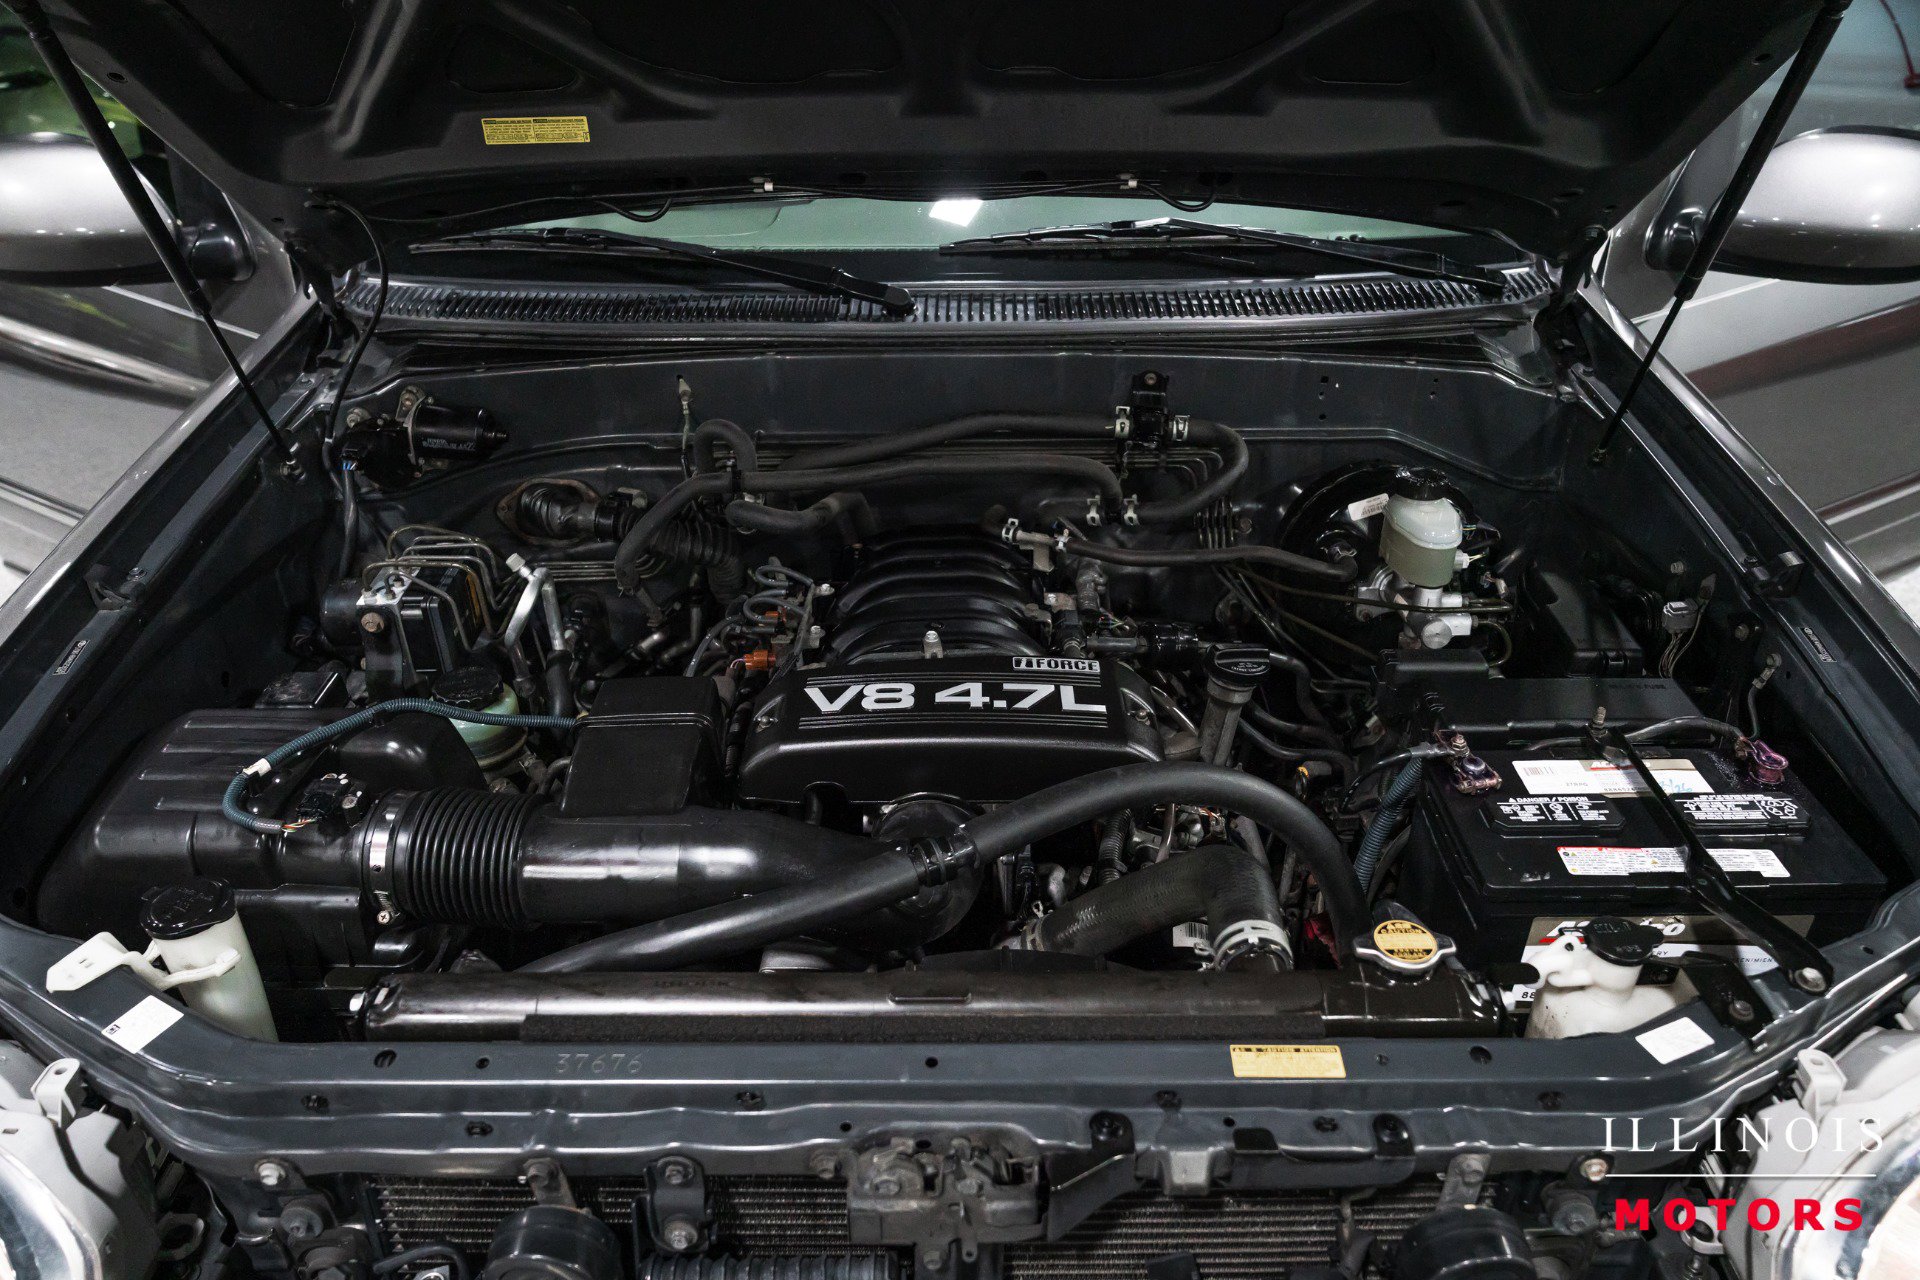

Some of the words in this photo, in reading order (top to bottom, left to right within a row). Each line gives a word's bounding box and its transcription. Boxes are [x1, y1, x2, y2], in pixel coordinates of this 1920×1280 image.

[803, 682, 915, 714] V8
[934, 682, 1107, 714] 4.7L
[555, 1053, 643, 1074] 37676
